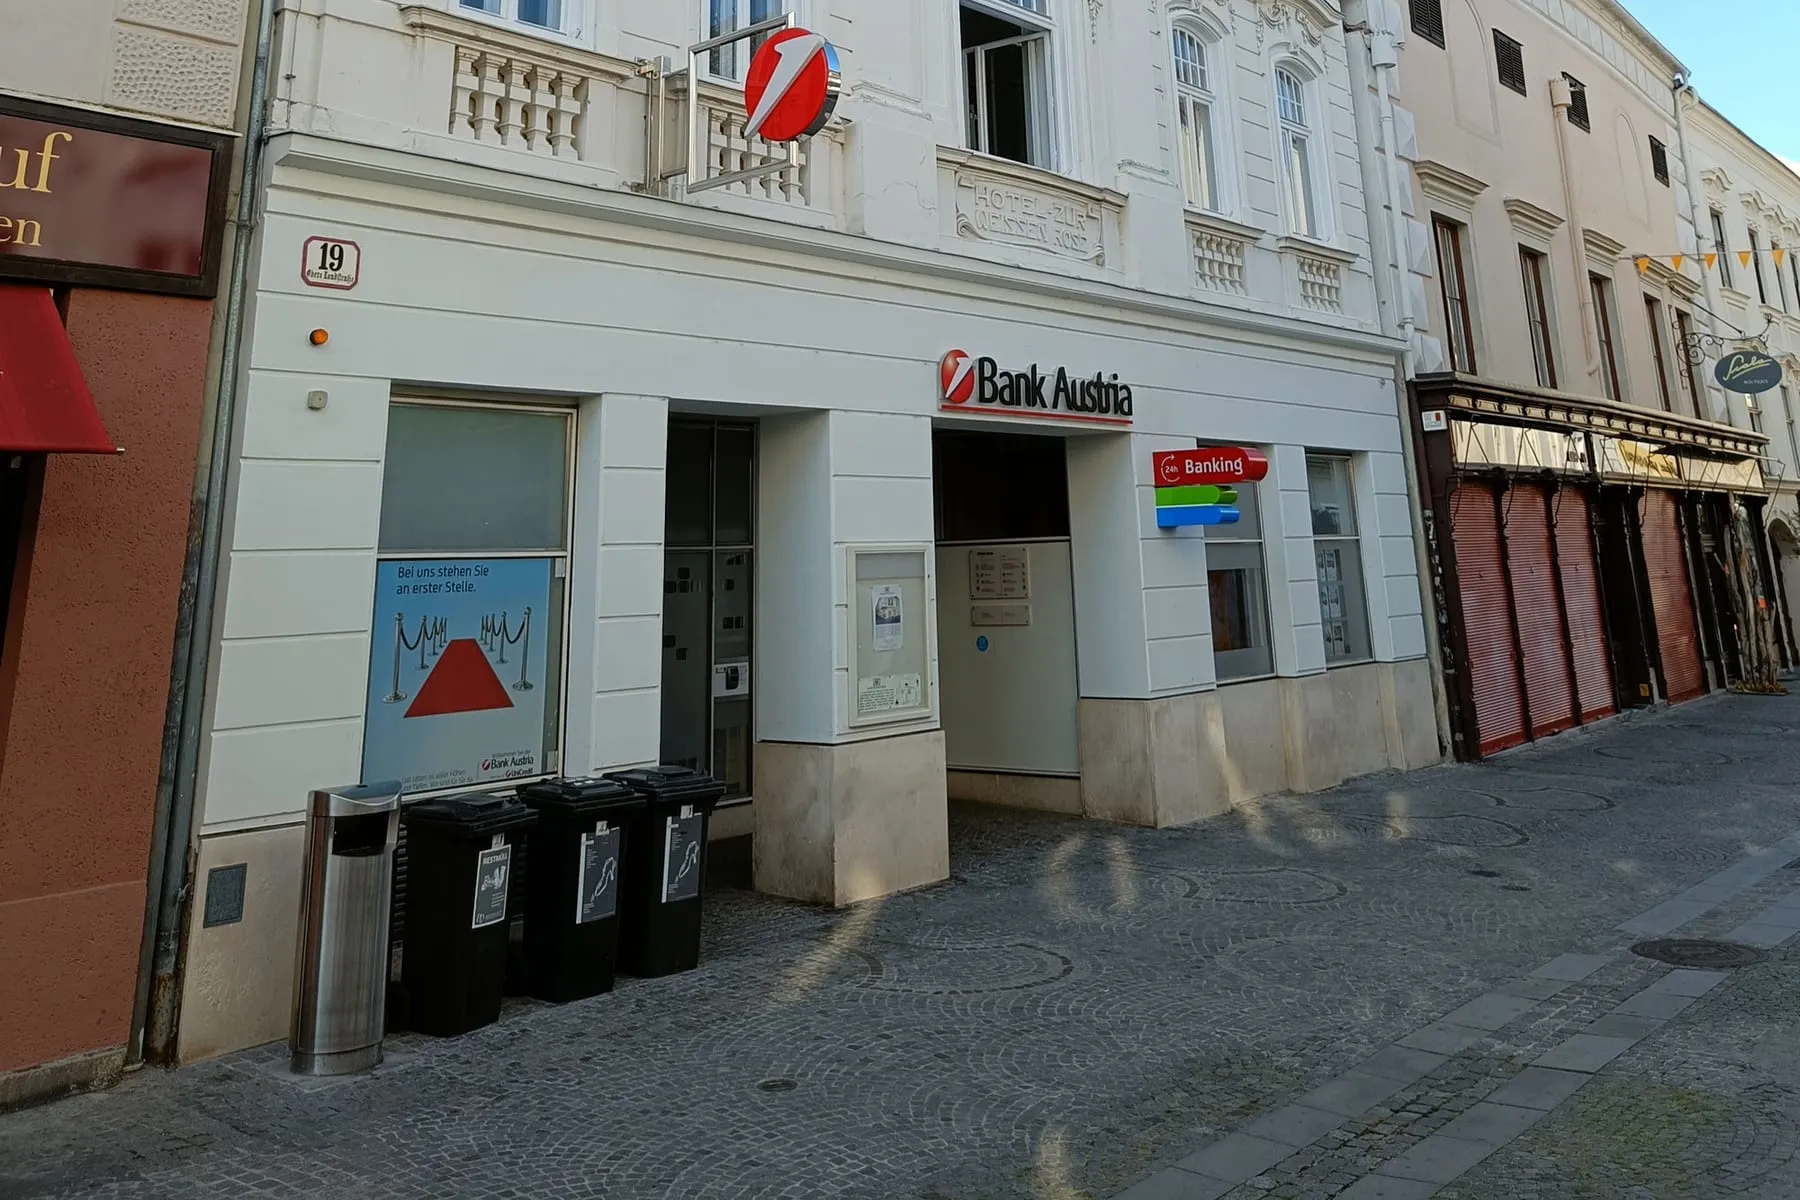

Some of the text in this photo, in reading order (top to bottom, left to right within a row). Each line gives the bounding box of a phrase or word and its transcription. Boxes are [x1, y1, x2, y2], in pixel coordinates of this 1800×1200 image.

[318, 242, 344, 272] 19
[978, 356, 1133, 417] Bank Austria
[1165, 457, 1243, 475] 24h Banking
[398, 564, 489, 579] Bei uns stehen Sie
[396, 580, 477, 595] an erster Stelle.
[491, 755, 534, 770] Bank Austria
[511, 767, 534, 777] UniCredit
